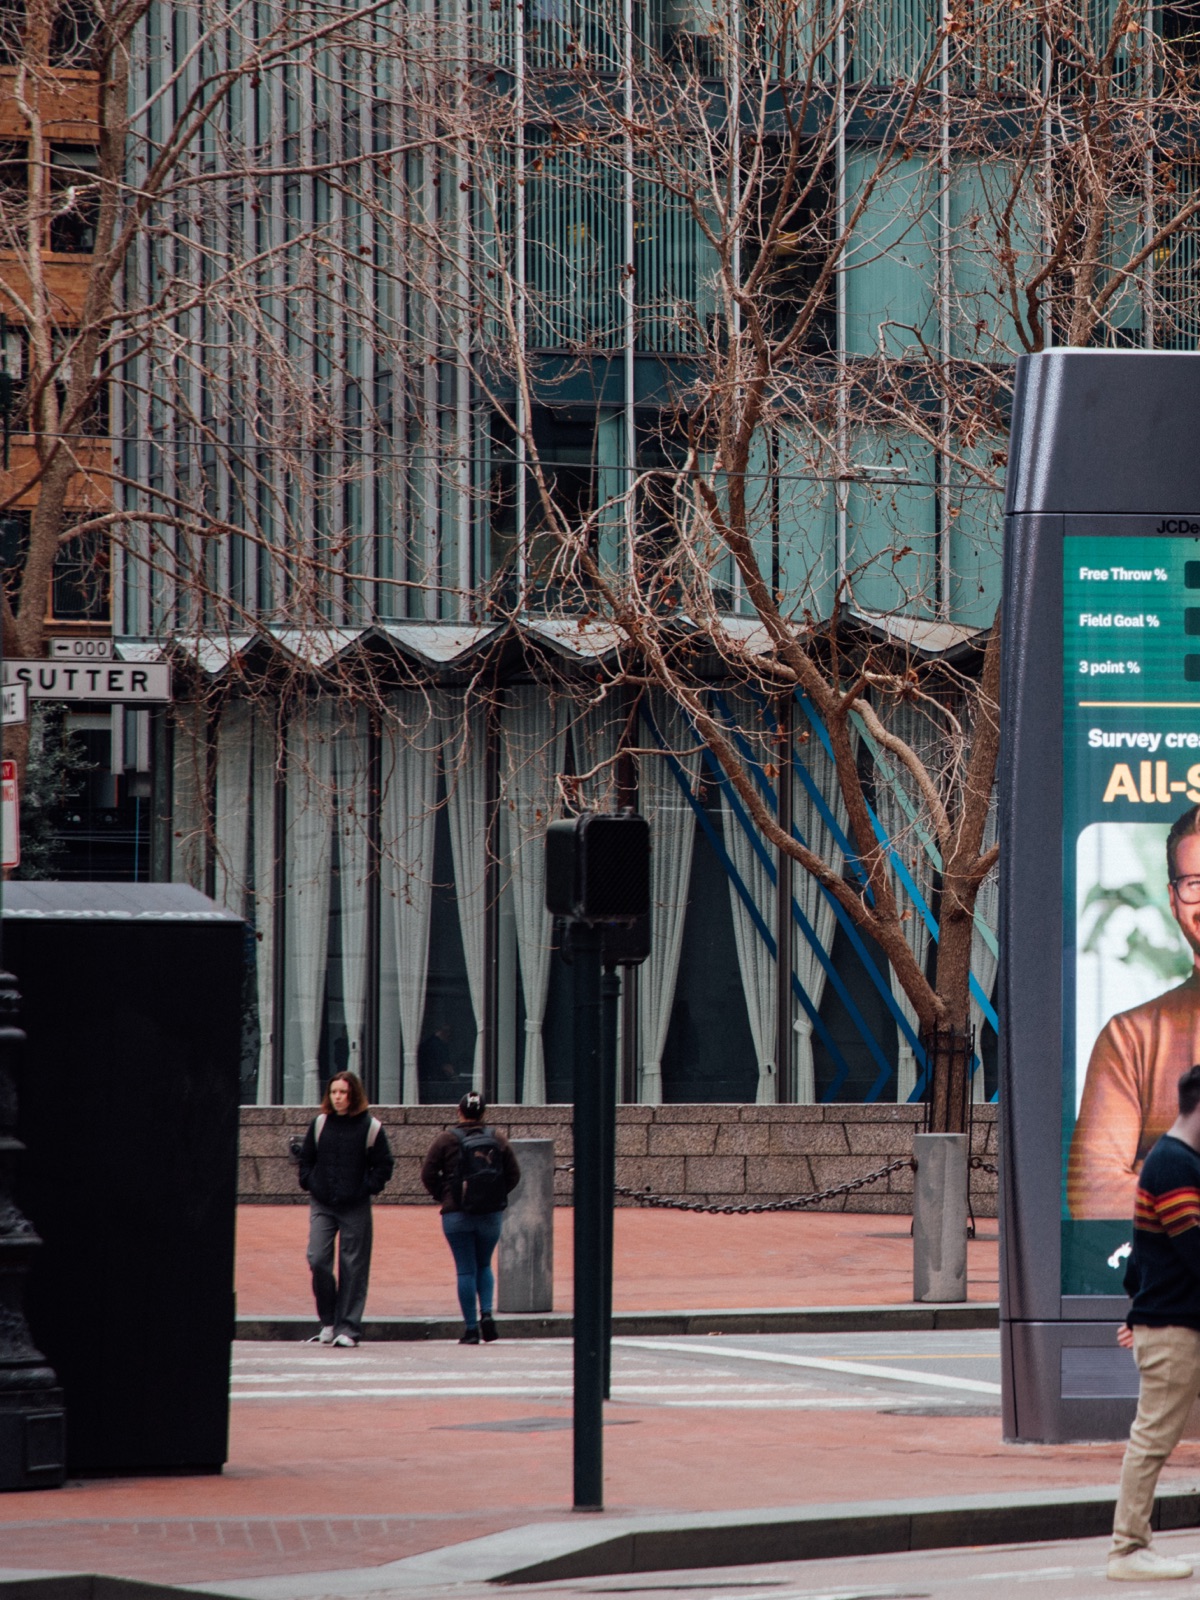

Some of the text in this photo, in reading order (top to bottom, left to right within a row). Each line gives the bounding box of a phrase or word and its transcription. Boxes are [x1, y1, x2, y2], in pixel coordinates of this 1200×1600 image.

[1079, 567, 1168, 581] Free Throw %
[1079, 614, 1160, 628] Field Goal %
[1079, 661, 1141, 677] 3 point %
[16, 668, 149, 692] SUTTER
[1088, 728, 1162, 752] Survey
